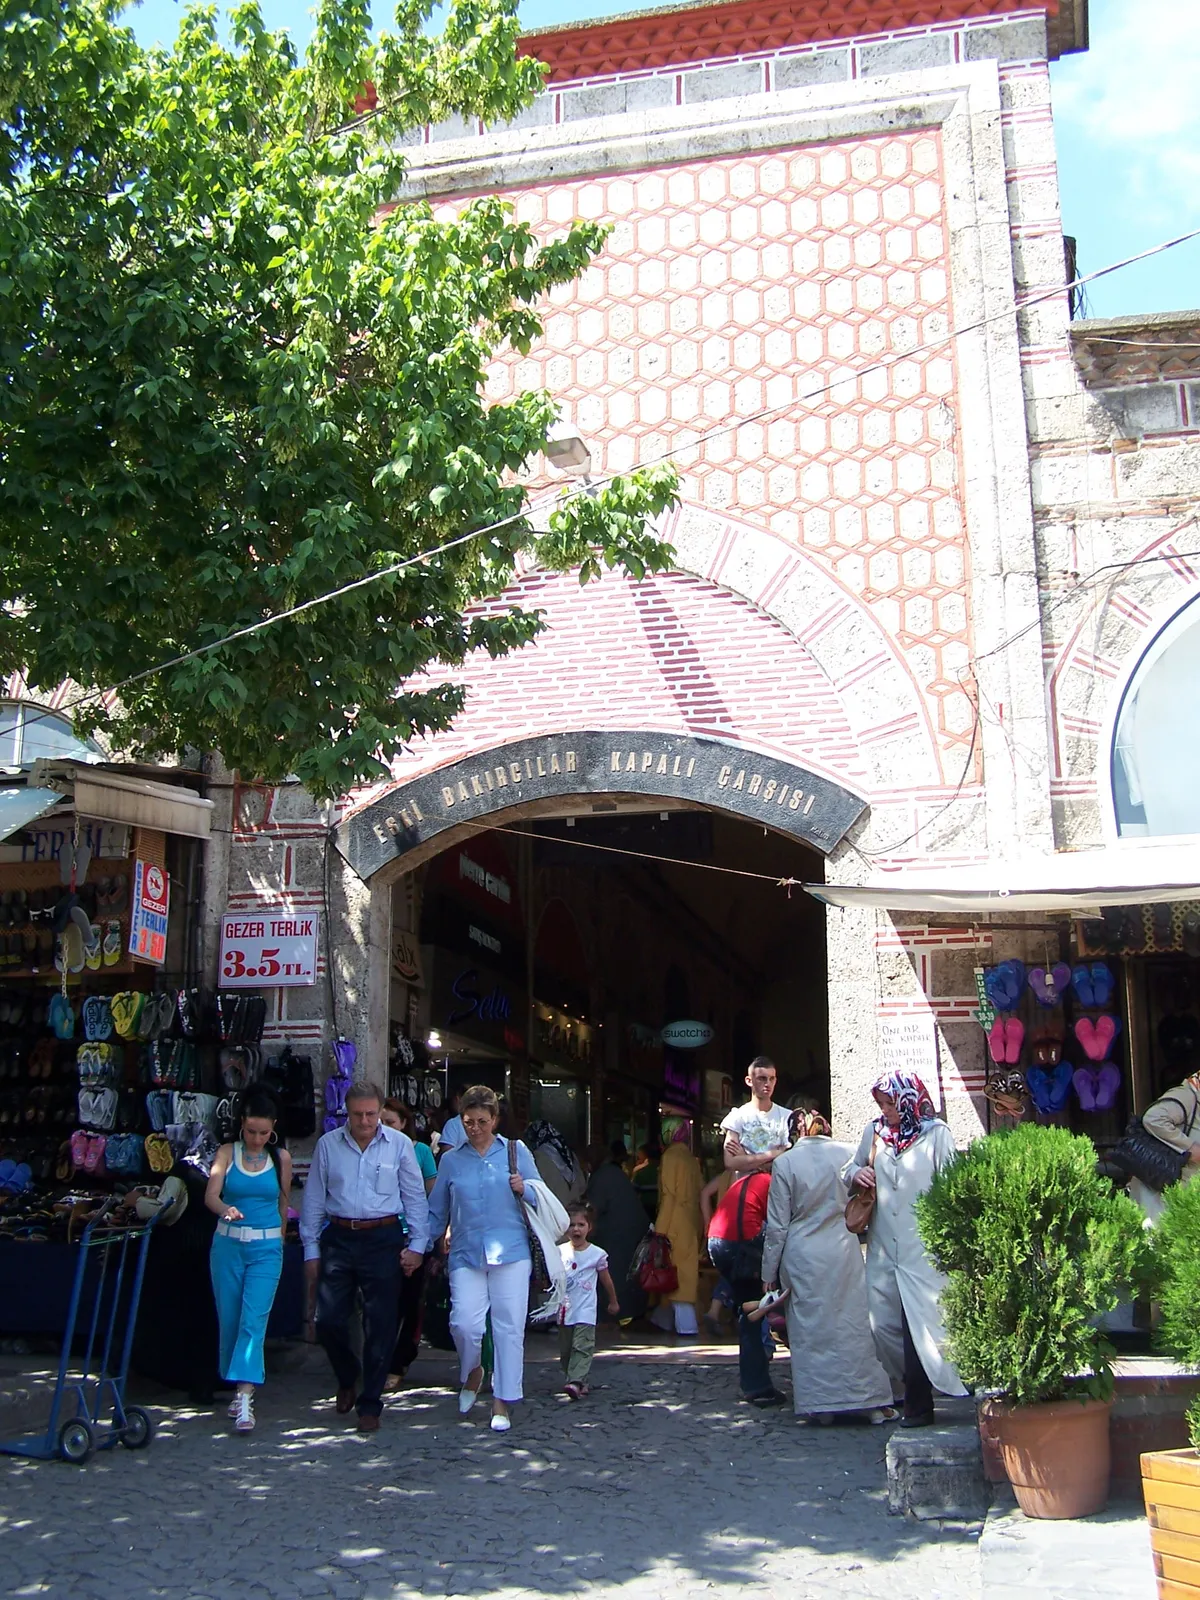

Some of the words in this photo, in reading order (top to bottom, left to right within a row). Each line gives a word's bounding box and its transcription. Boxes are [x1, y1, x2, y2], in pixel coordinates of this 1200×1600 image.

[441, 751, 578, 808] BAKIRCILAR
[610, 751, 696, 778] KAPALI
[717, 765, 816, 816] ÇARŞISI
[132, 863, 143, 950] GEZER
[143, 898, 166, 914] GEZER
[225, 921, 265, 939] GEZER
[223, 947, 281, 979] 3.5
[281, 963, 312, 976] TL.
[976, 974, 988, 1012] BURASI
[663, 1028, 703, 1039] swatch
